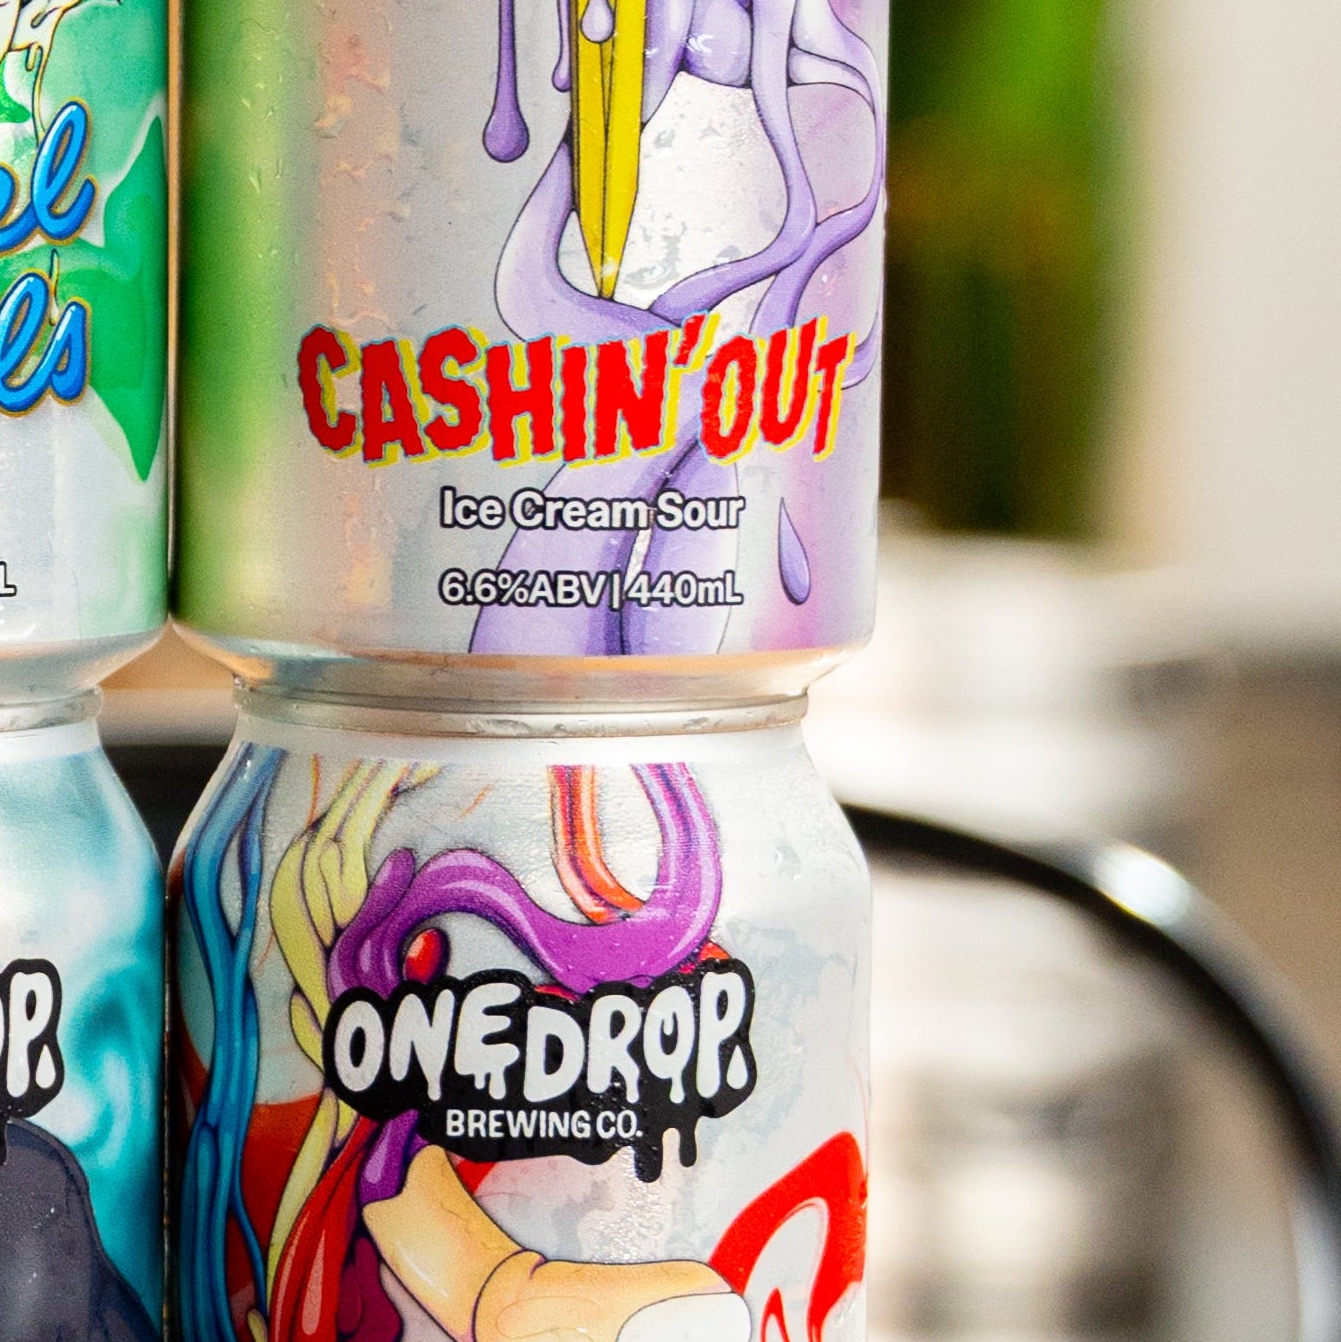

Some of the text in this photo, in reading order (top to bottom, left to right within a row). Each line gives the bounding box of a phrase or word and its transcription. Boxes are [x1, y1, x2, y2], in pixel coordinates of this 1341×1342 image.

[440, 486, 745, 529] Ice Cream Sour
[446, 1109, 642, 1139] BREWING CO.
